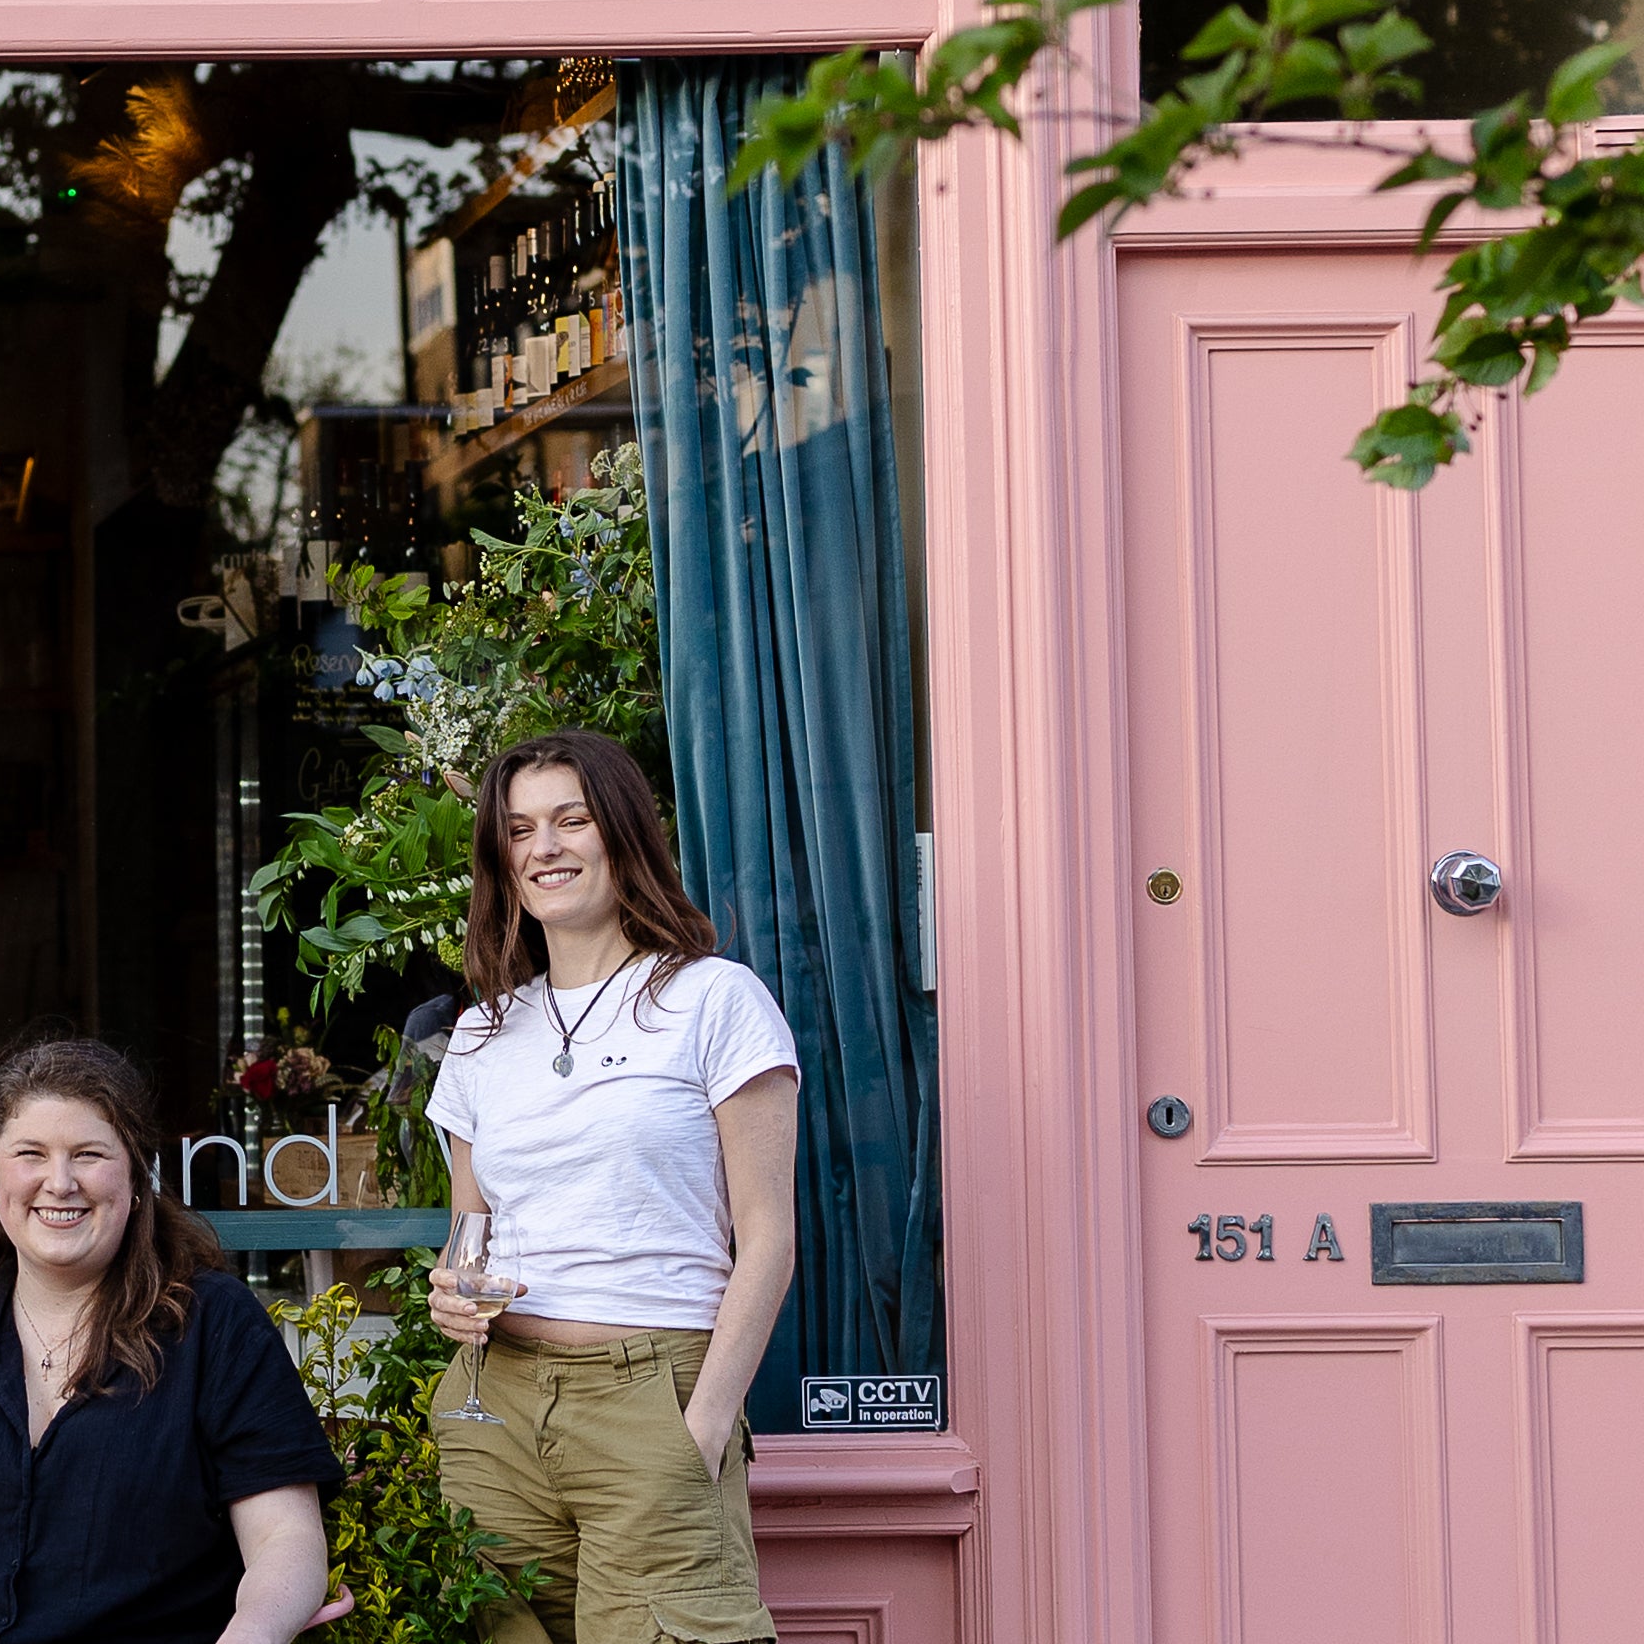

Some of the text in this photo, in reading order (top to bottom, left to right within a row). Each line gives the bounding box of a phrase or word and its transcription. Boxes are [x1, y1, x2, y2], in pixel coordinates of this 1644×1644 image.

[149, 1103, 338, 1207] nd
[1188, 1212, 1345, 1262] 151 A
[858, 1381, 932, 1403] CCTV
[874, 1408, 933, 1423] operation
